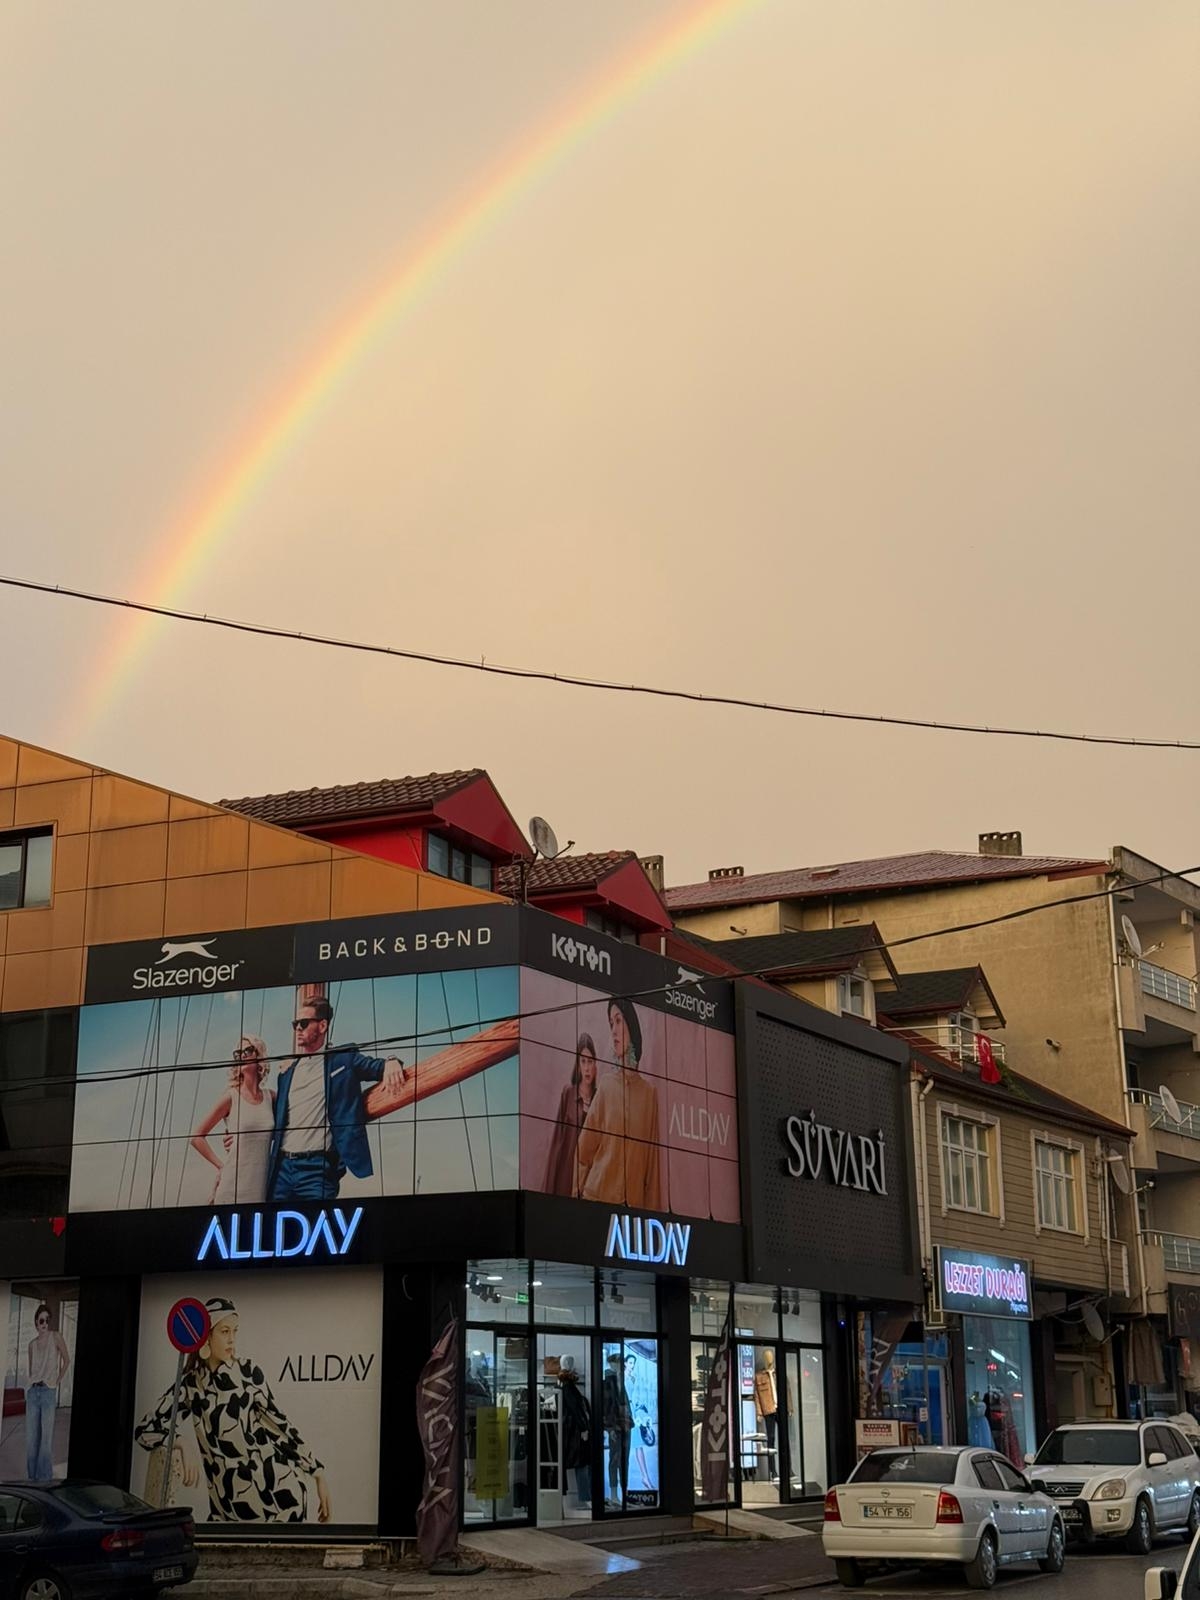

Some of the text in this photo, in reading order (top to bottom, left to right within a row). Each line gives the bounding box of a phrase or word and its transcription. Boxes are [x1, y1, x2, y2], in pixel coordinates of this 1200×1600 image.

[319, 927, 491, 960] BACK & BOND
[132, 962, 240, 989] Slazenger
[665, 983, 717, 1020] Slazenger
[669, 1103, 731, 1147] ALLDAY
[786, 1108, 888, 1196] SÜVARİ
[197, 1207, 364, 1261] ALLDAY
[604, 1213, 691, 1266] ALLDAY
[944, 1260, 1027, 1303] LEZZET DURAĞI
[278, 1353, 375, 1382] ALLDAY
[869, 1507, 879, 1516] 54
[882, 1507, 893, 1517] YF
